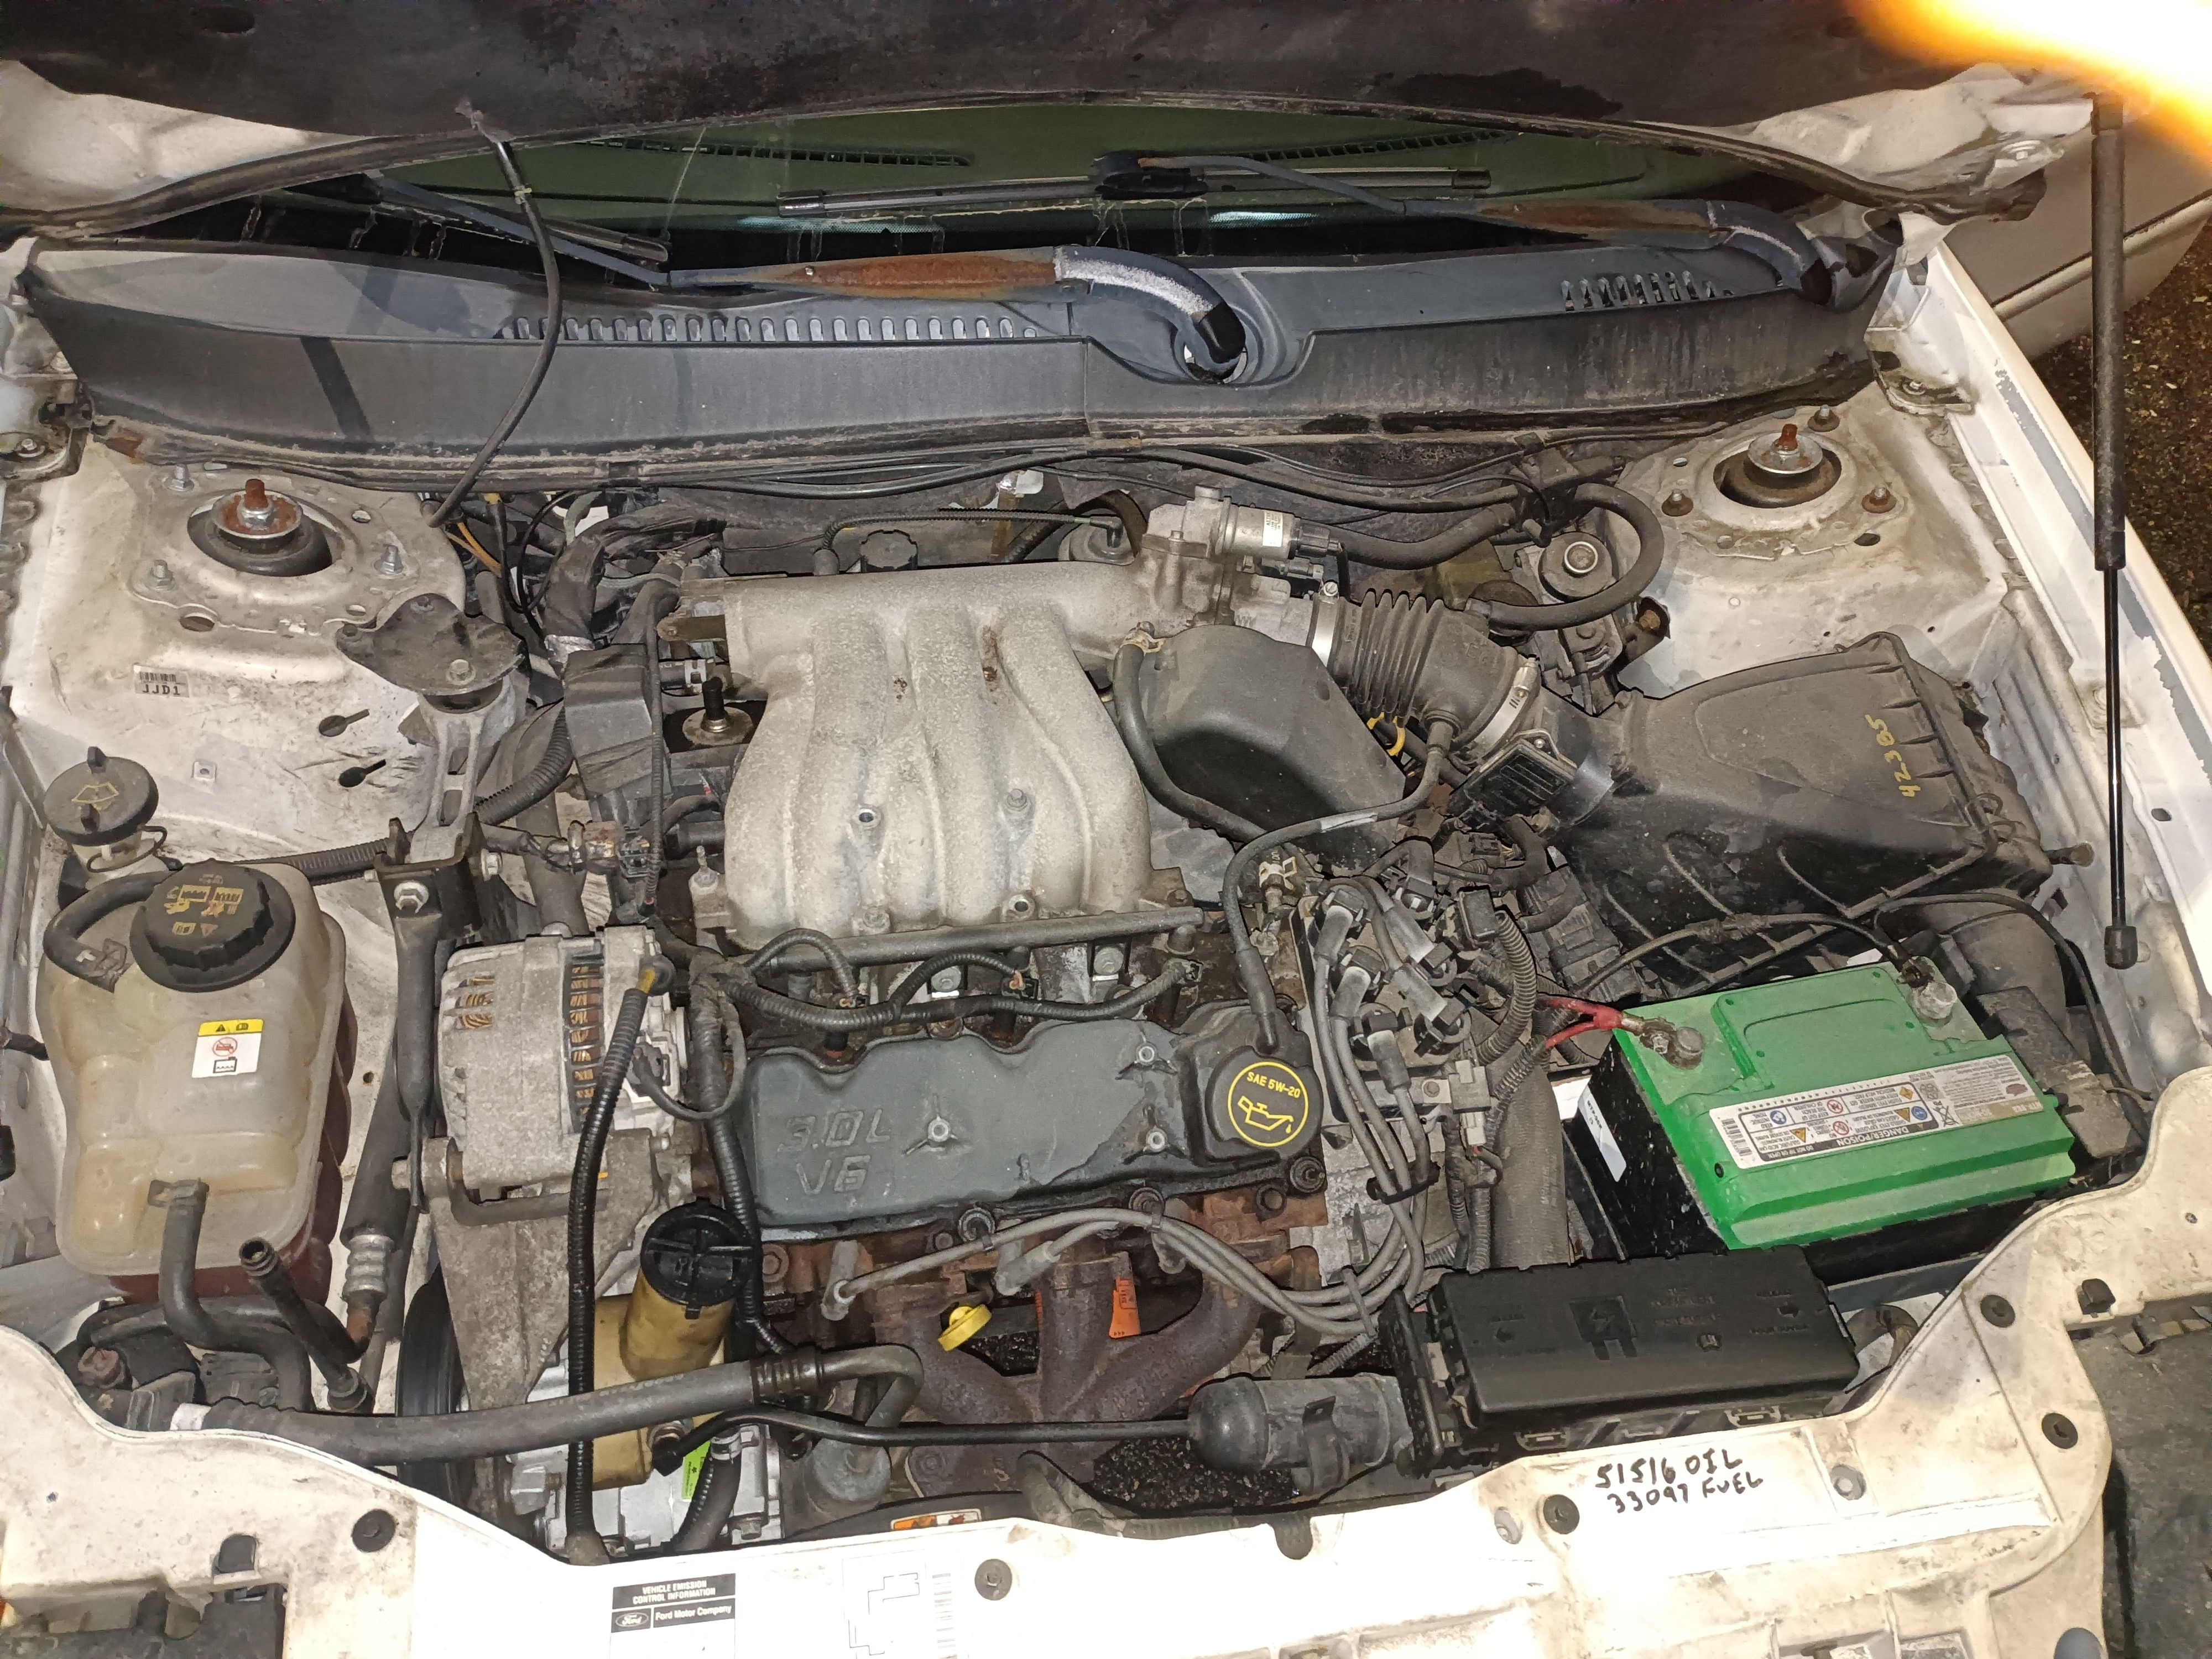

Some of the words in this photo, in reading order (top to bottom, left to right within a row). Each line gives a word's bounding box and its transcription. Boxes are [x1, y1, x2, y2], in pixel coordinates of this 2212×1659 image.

[142, 684, 181, 696] JJD1
[1246, 1071, 1267, 1087] SAE
[1268, 1078, 1301, 1098] 5W-20
[777, 1108, 890, 1152] 3.0L
[1835, 1126, 1909, 1146] DANGER/POISON
[796, 1155, 871, 1195] V6
[1595, 1457, 1676, 1489] 51516
[1685, 1448, 1743, 1475] OIL
[1607, 1483, 1688, 1514] 33097
[1702, 1471, 1764, 1498] FUEL
[633, 1594, 666, 1605] CONTROL
[667, 1588, 716, 1600] INFORMATION
[642, 1584, 671, 1595] VEHICLE
[672, 1580, 707, 1591] EMISSION
[655, 1610, 672, 1621] Ford
[674, 1609, 696, 1618] Motor
[697, 1605, 732, 1616] Company
